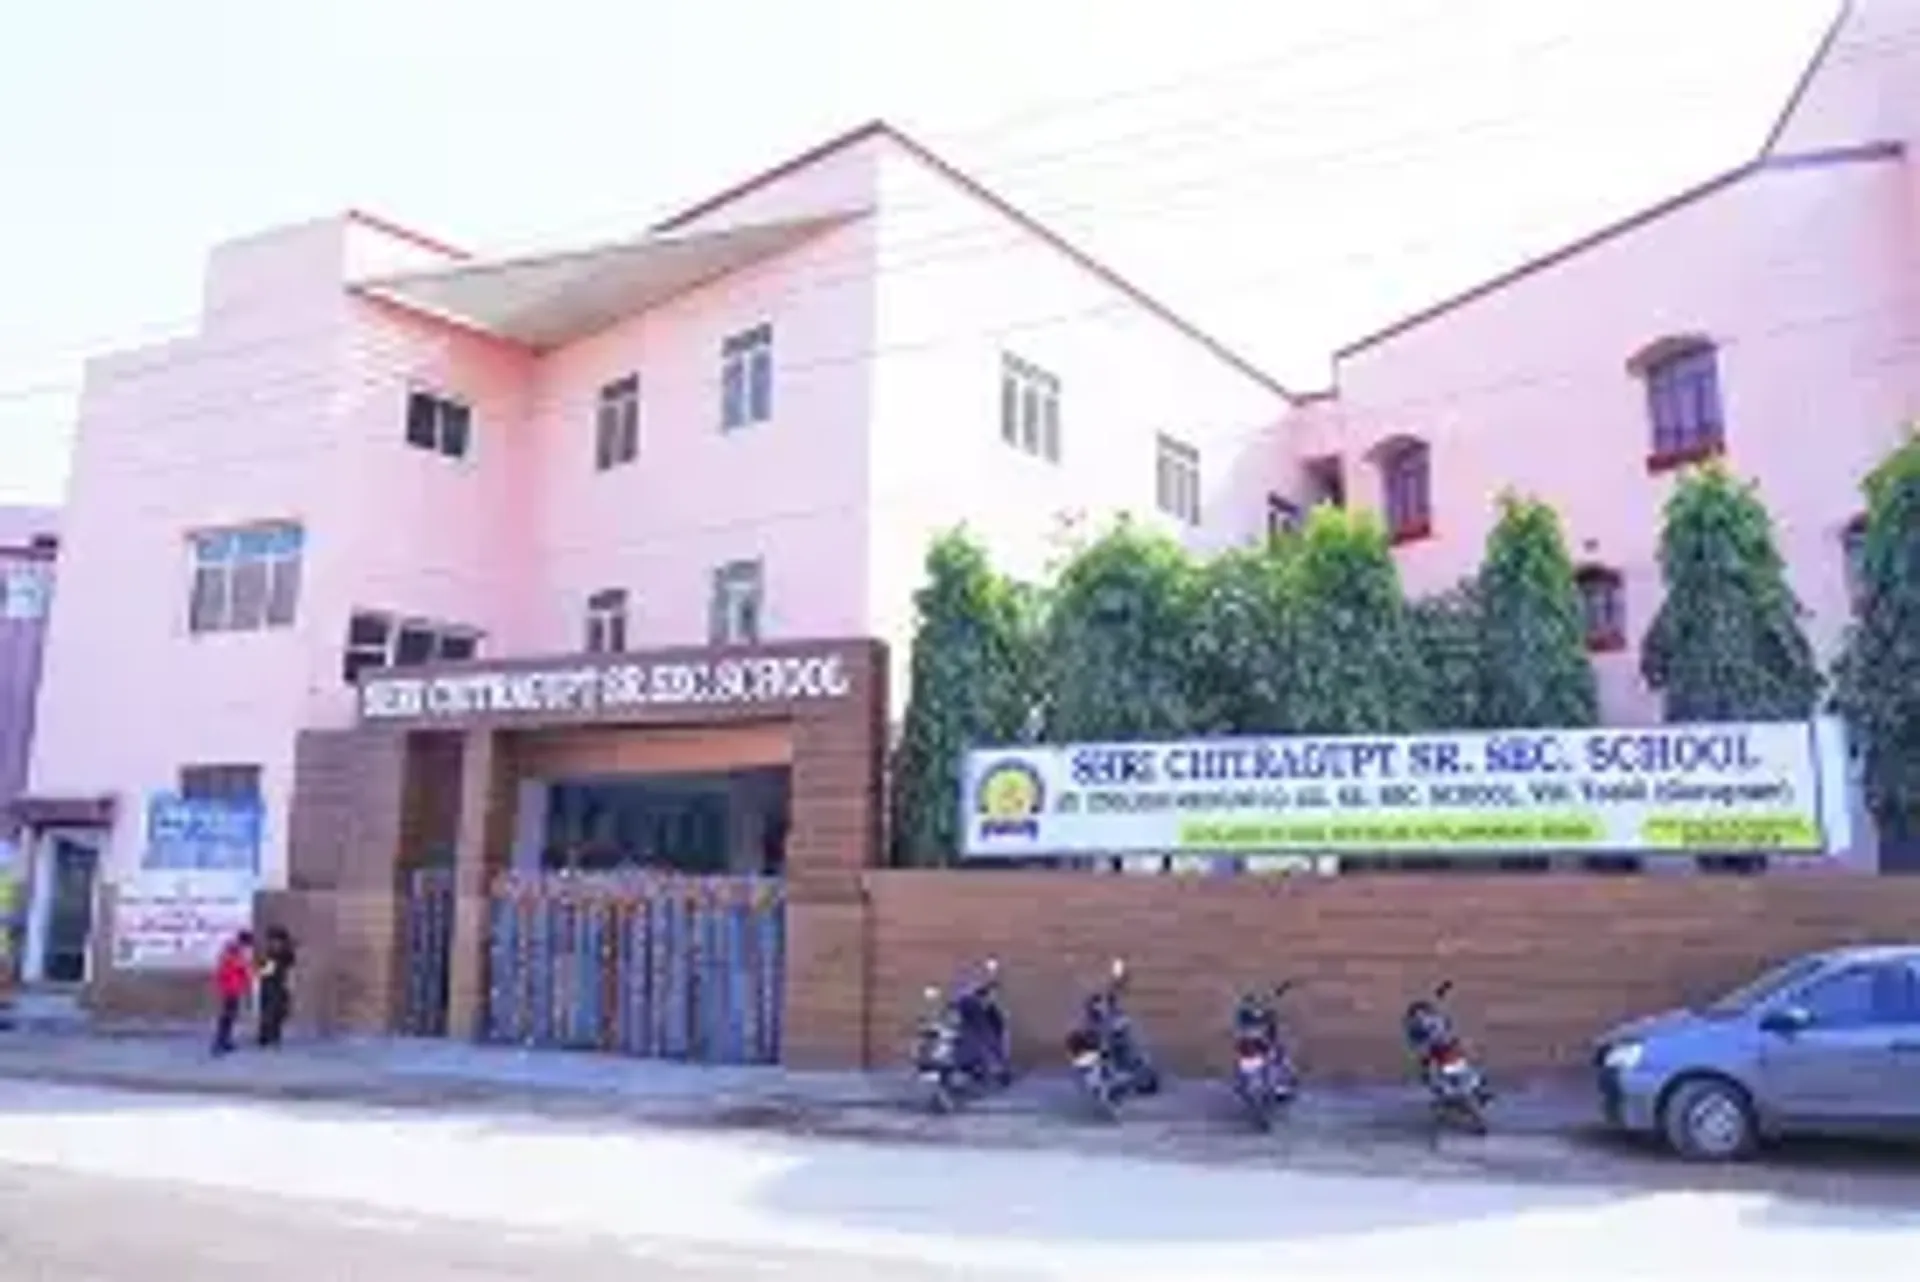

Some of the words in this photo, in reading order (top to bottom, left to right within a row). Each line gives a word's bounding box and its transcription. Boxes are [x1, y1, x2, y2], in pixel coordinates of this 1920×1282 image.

[711, 656, 849, 701] SCHOOL
[1071, 747, 1157, 785] SHRI
[1163, 740, 1397, 781] CHITRAGUPT
[1407, 741, 1475, 775] SR.
[1485, 736, 1573, 773] SEC.
[1584, 733, 1761, 773] SCHOOL
